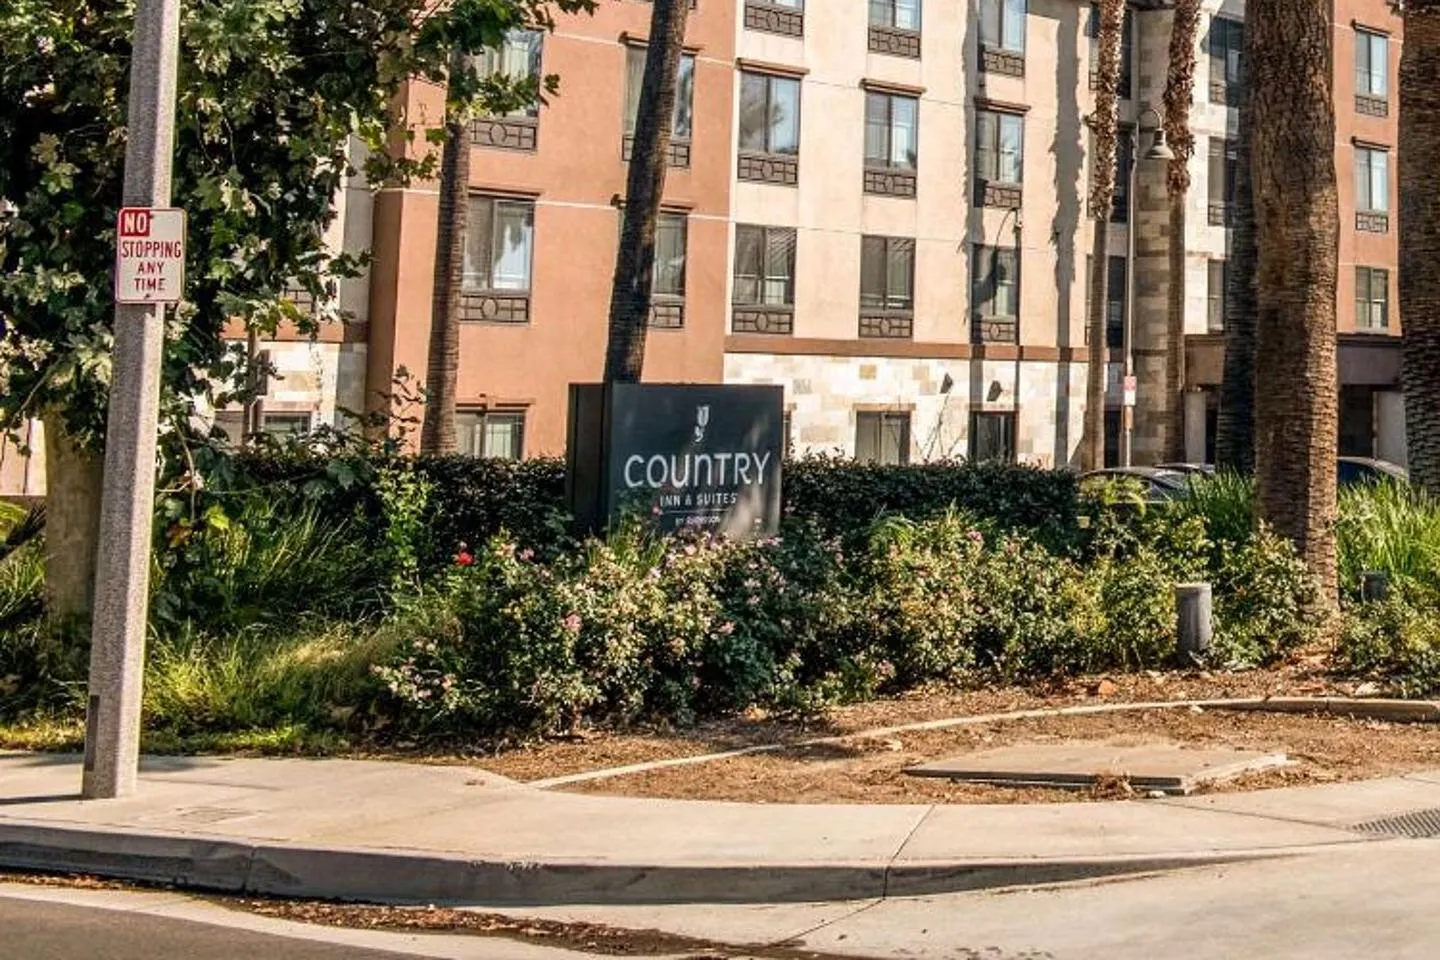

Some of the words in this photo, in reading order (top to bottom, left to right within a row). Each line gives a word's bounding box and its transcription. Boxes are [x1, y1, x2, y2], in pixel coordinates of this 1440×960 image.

[124, 212, 147, 233] NO
[121, 241, 181, 258] STOPPING
[137, 262, 164, 274] ANY
[134, 278, 166, 291] TIME
[624, 451, 770, 489] COUNTRY
[659, 494, 681, 507] INN
[696, 492, 737, 506] SUITES
